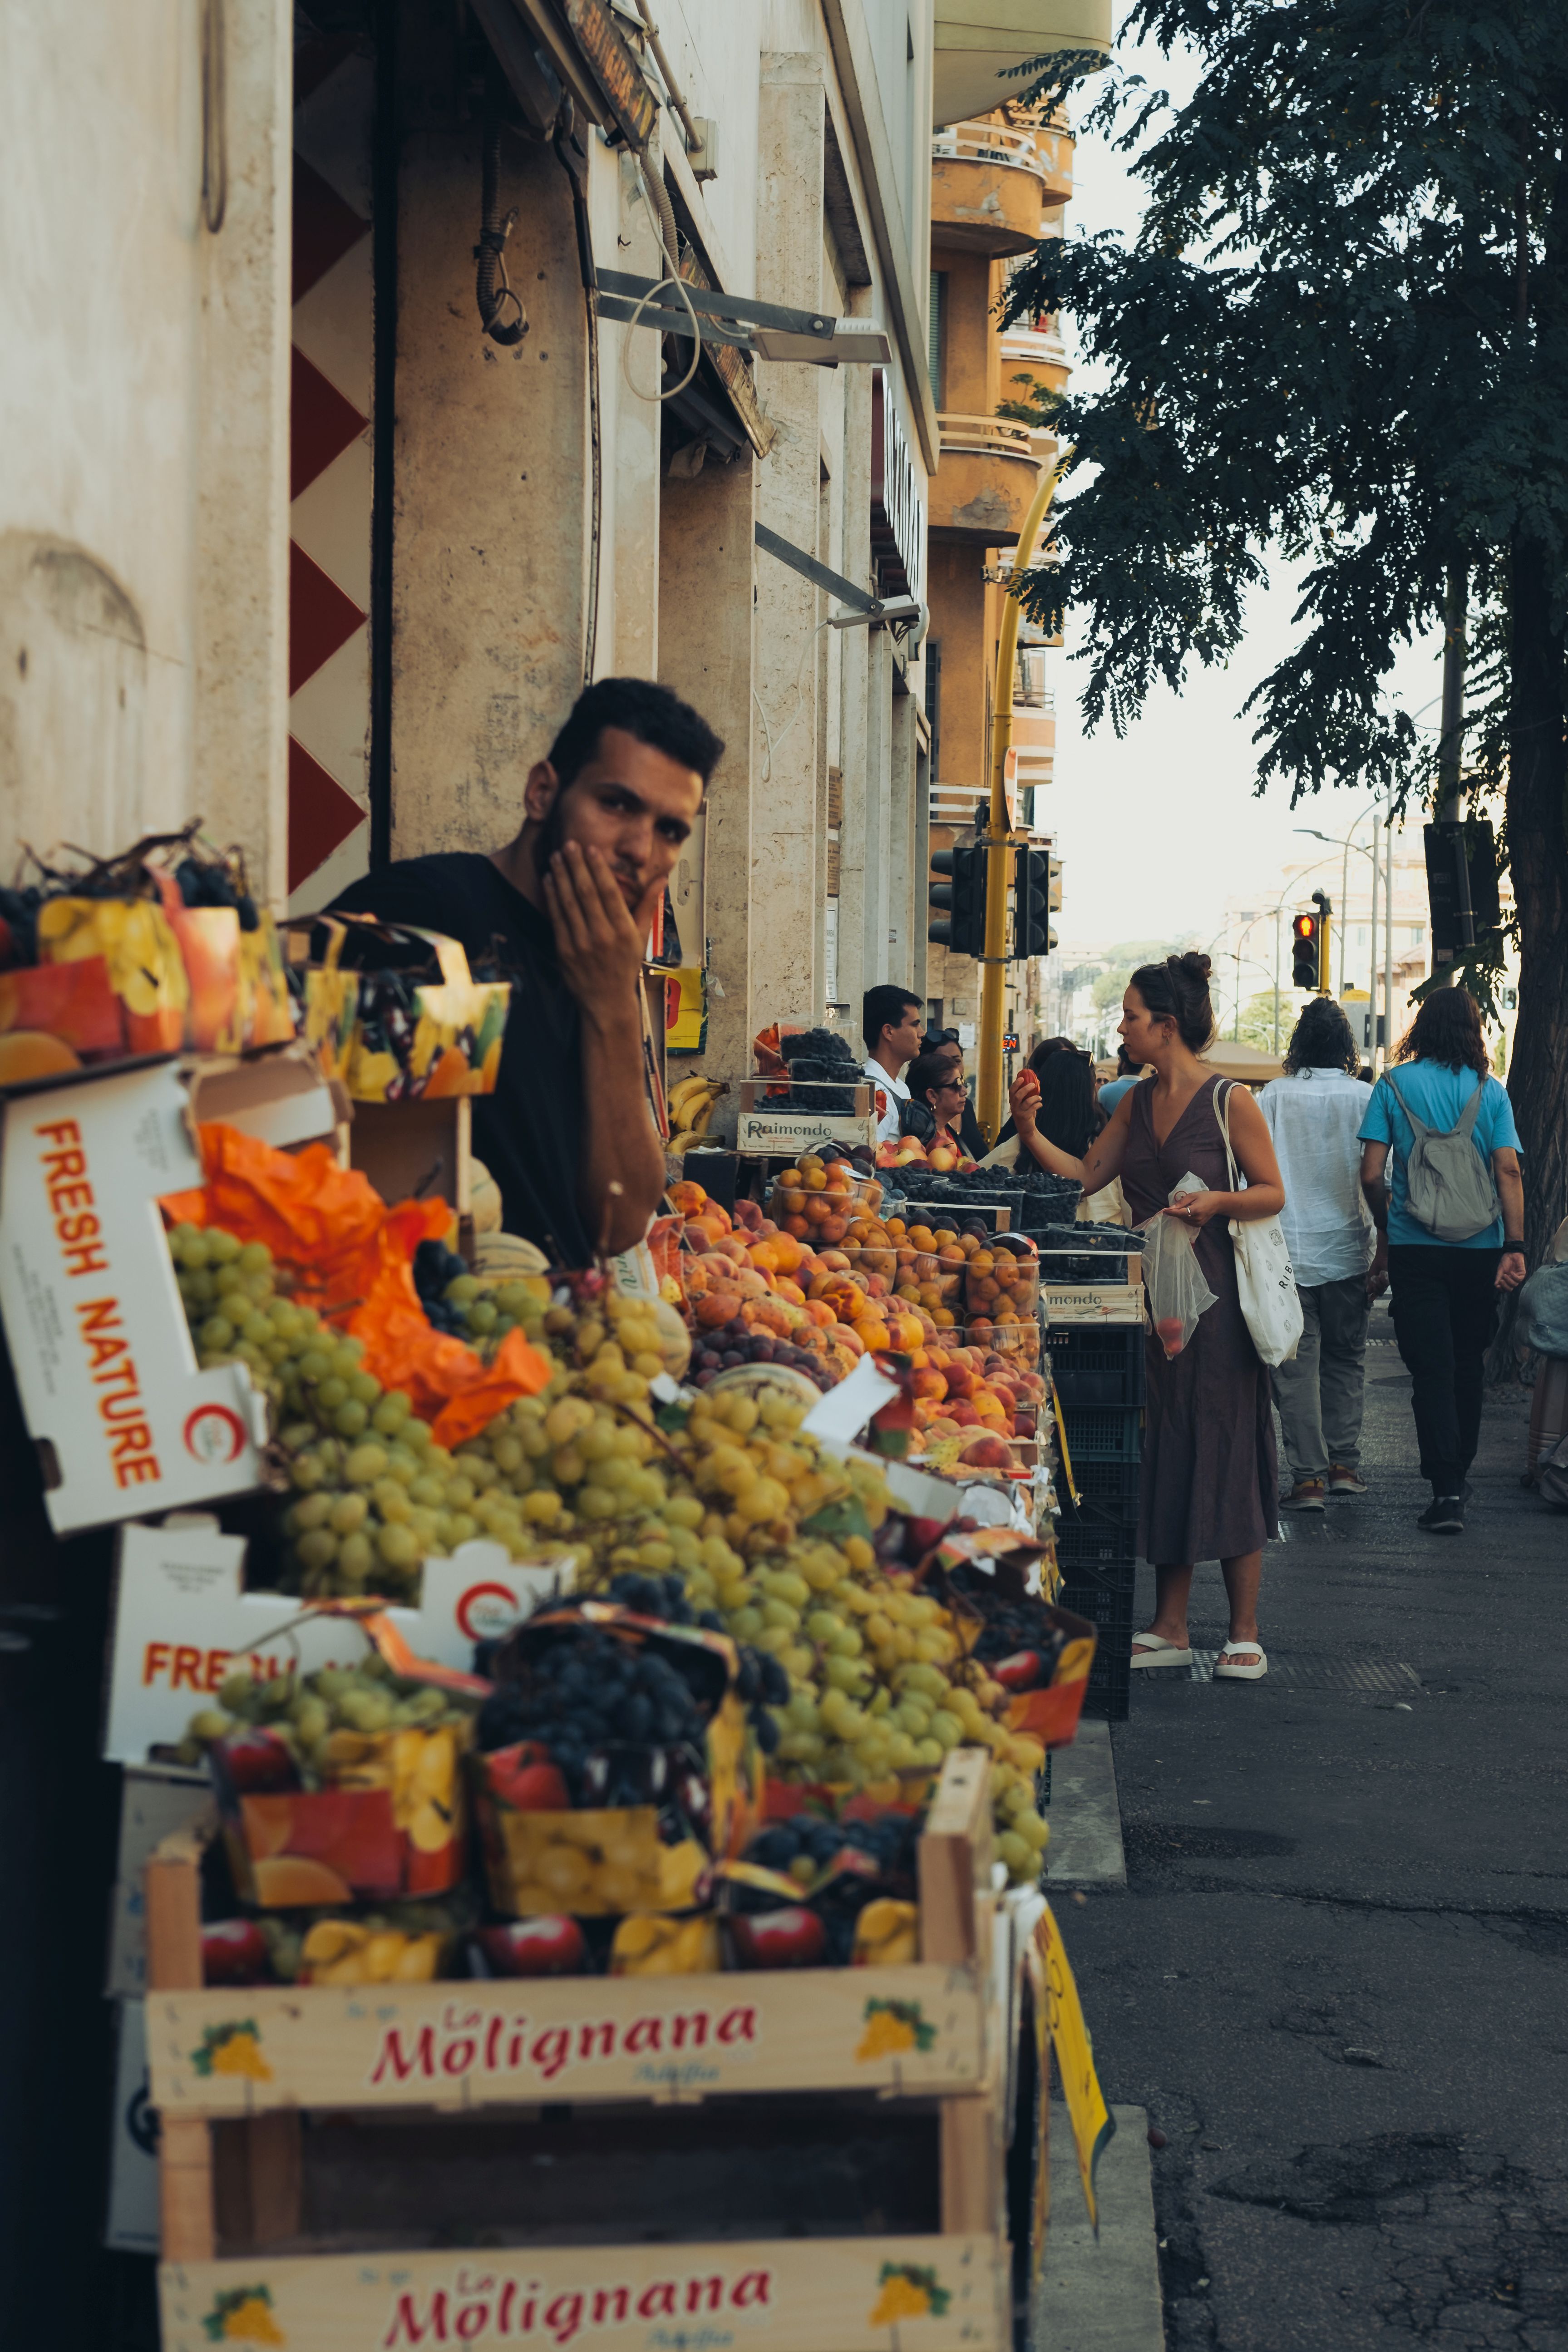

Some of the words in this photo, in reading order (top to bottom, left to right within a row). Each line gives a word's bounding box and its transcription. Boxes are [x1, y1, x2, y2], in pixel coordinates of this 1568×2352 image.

[1002, 1040, 1017, 1049] EN
[748, 1120, 832, 1139] Raimondo
[34, 1118, 109, 1278] FRESH
[1050, 1292, 1102, 1305] mondo
[1278, 1260, 1292, 1290] RIB
[75, 1295, 162, 1489] NATURE
[371, 2004, 756, 2085] Molignana
[385, 2269, 771, 2347] Molignana
